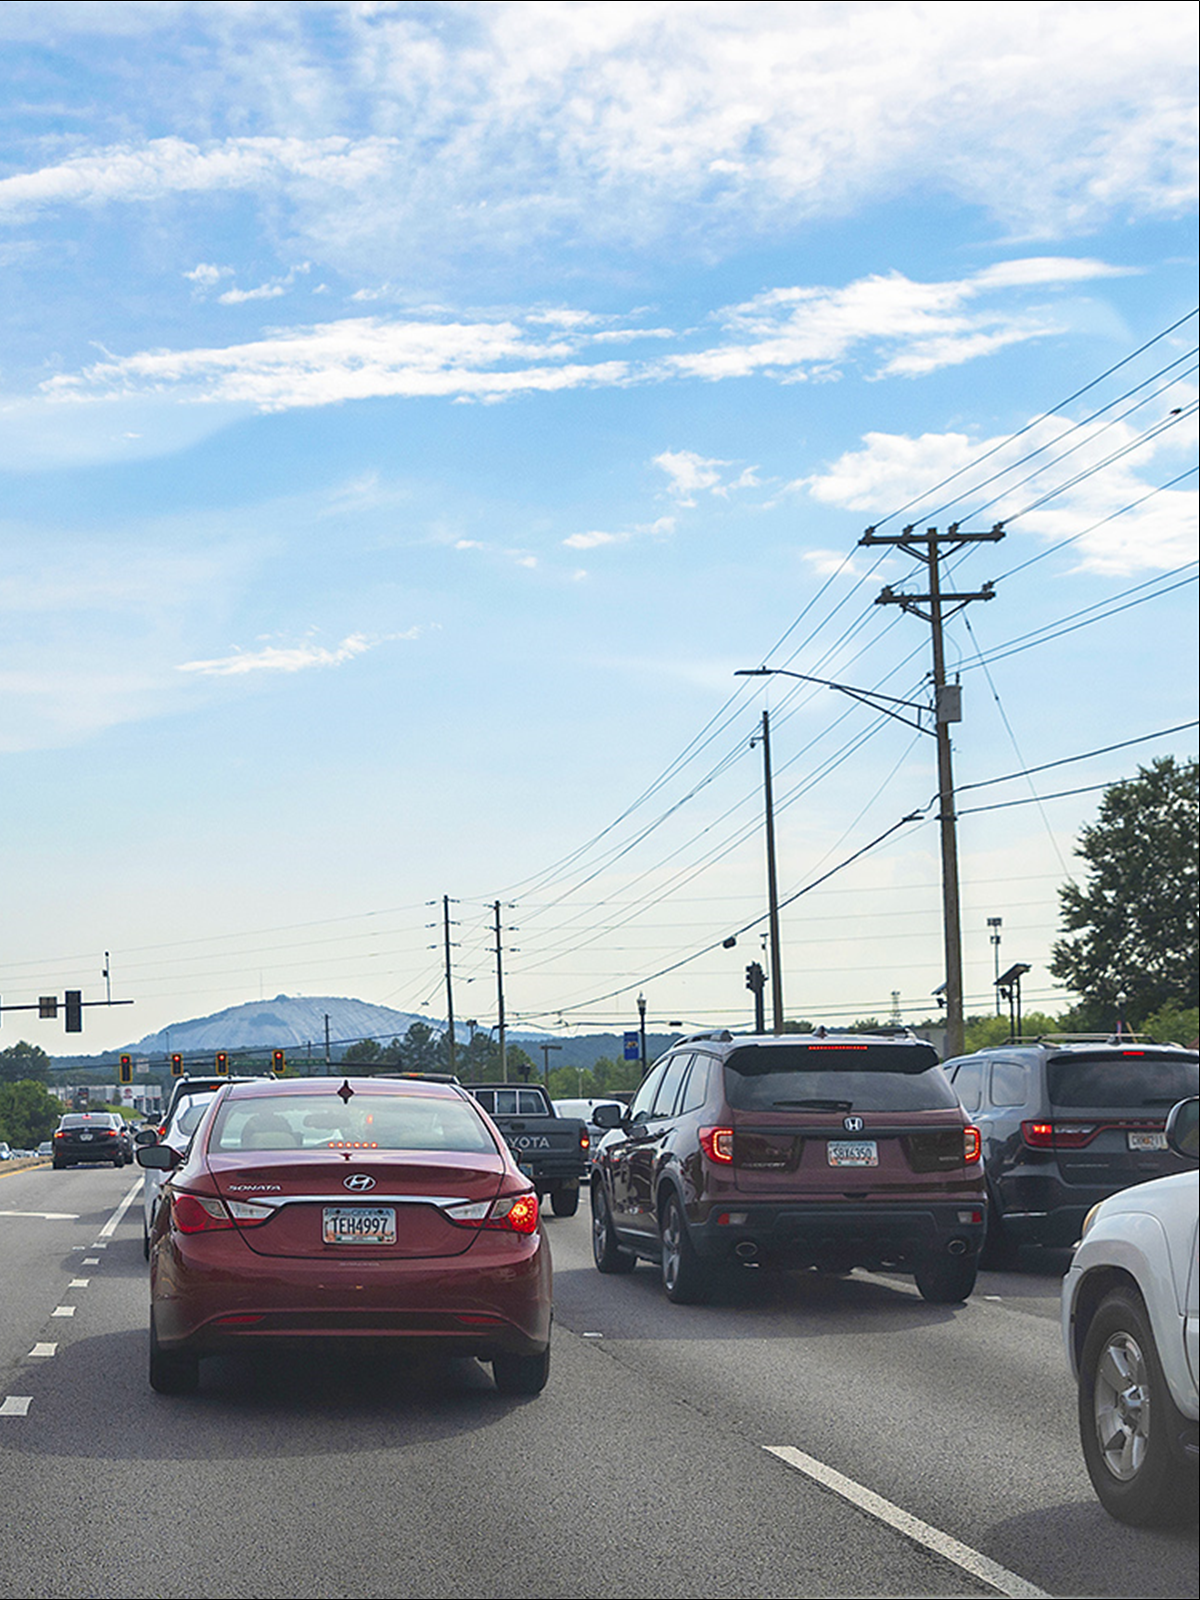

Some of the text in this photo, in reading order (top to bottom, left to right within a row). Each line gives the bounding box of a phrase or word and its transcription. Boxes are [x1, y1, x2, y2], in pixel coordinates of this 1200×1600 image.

[508, 1136, 550, 1149] YOTA
[227, 1184, 281, 1192] SONATA
[330, 1216, 389, 1235] TEH4997
